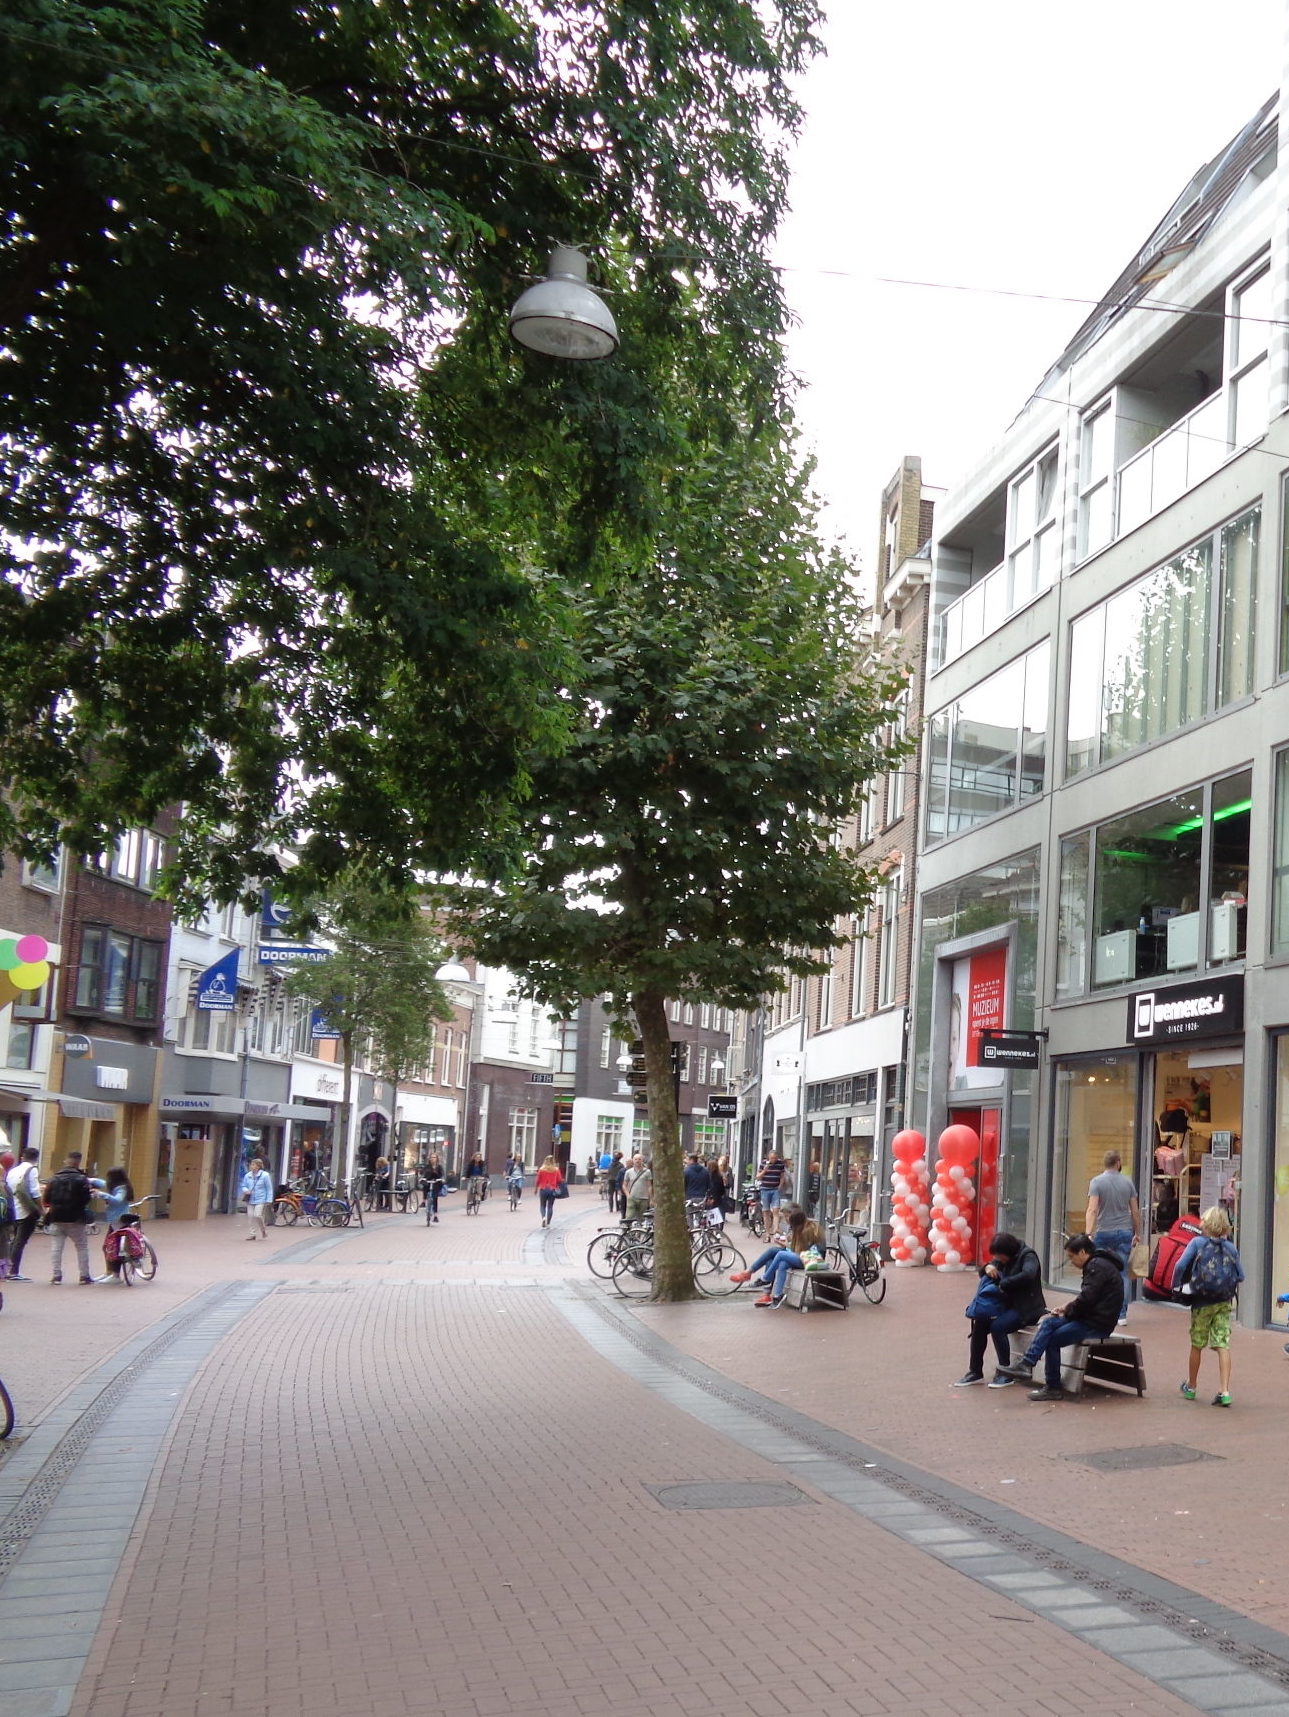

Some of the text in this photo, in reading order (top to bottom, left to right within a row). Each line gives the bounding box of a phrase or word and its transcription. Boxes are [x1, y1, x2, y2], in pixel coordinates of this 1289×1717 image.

[199, 1001, 233, 1010] DOORMAN
[972, 998, 999, 1017] MUZIEUM
[533, 1073, 553, 1083] FIFTH
[163, 1098, 210, 1108] DOORMAN
